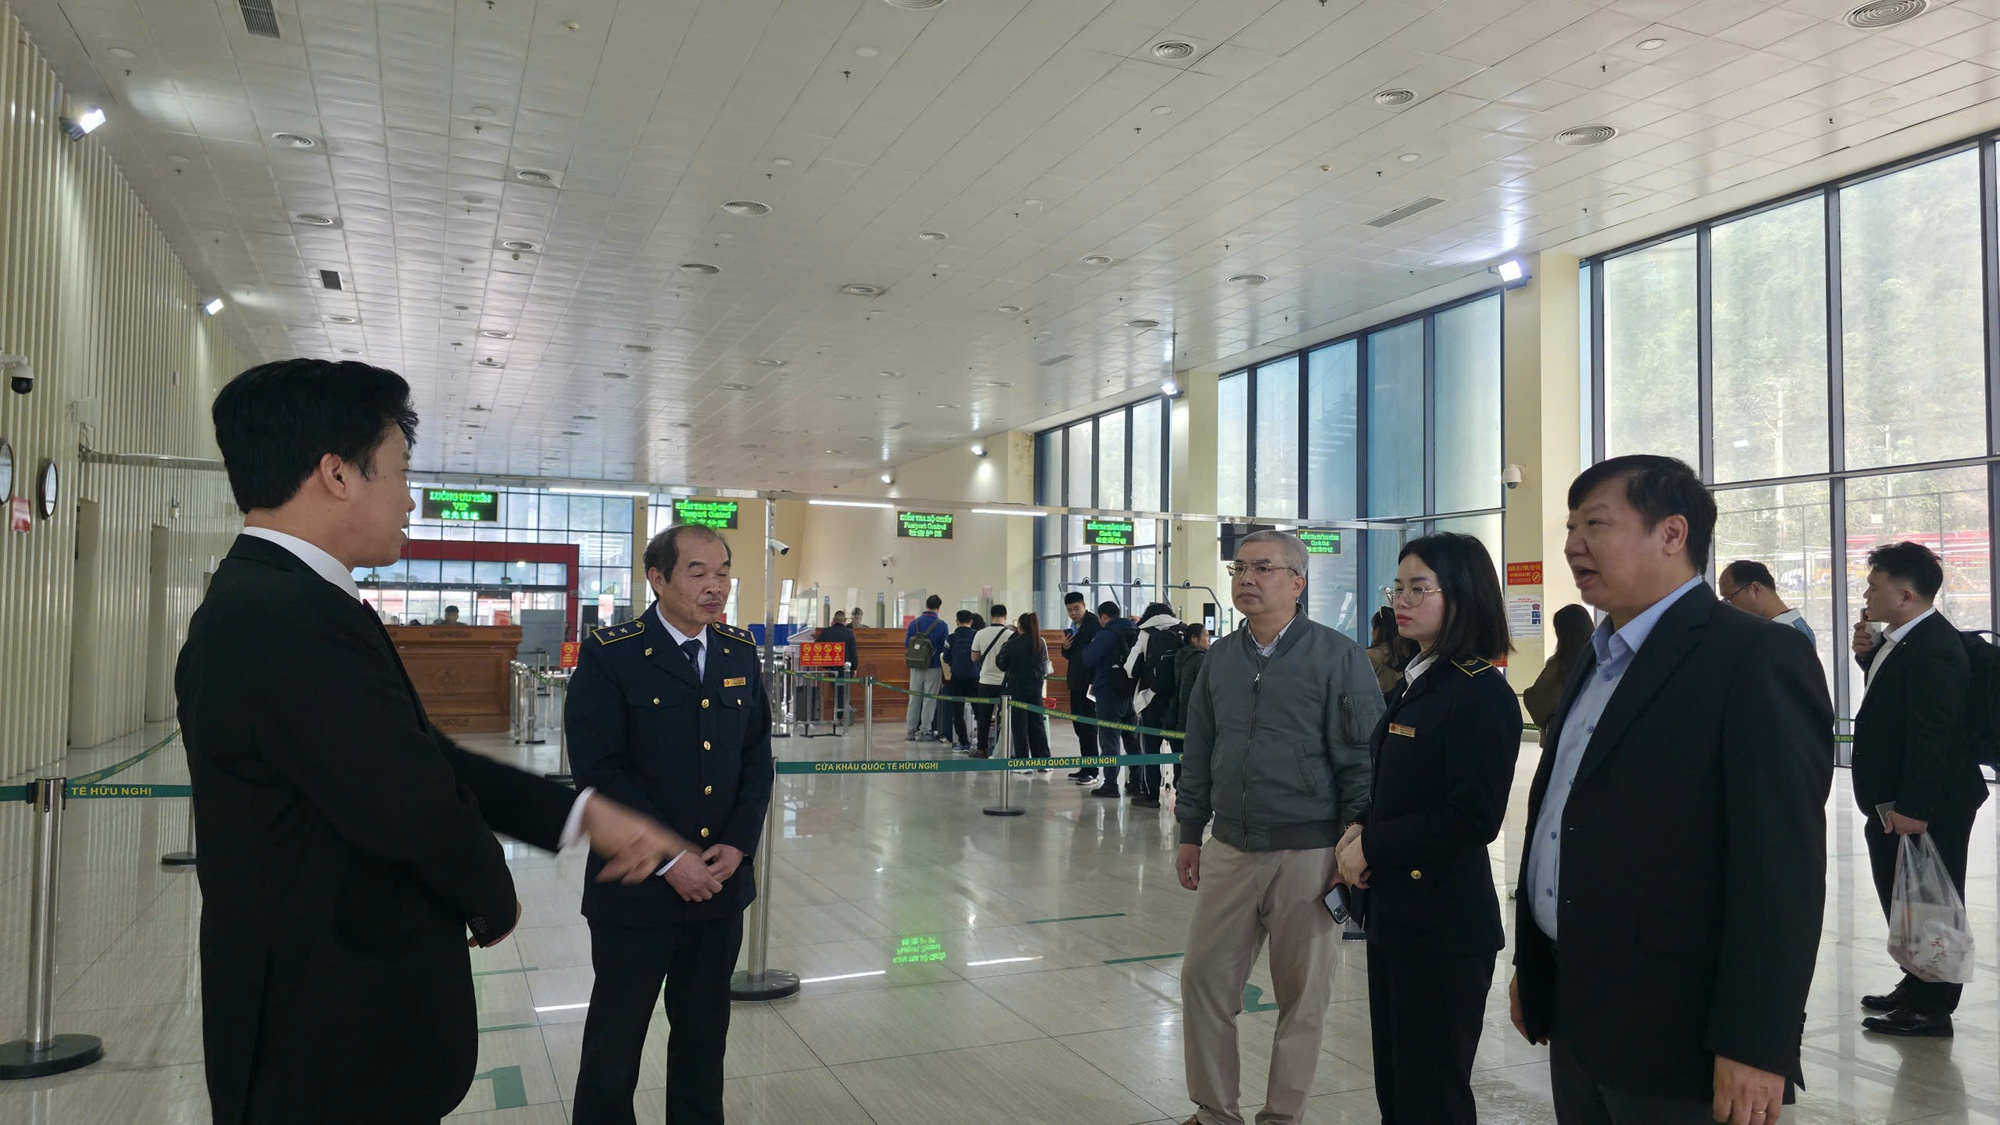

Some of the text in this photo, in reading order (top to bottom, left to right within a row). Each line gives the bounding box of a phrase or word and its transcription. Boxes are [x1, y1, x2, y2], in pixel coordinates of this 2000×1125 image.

[452, 501, 469, 511] VIP
[903, 521, 947, 531] Passport Control
[1099, 756, 1117, 765] NGHỊ
[899, 761, 917, 770] HỮU
[918, 761, 938, 771] NGHỊ
[90, 785, 118, 796] HỮU
[121, 787, 152, 797] NGHỊ
